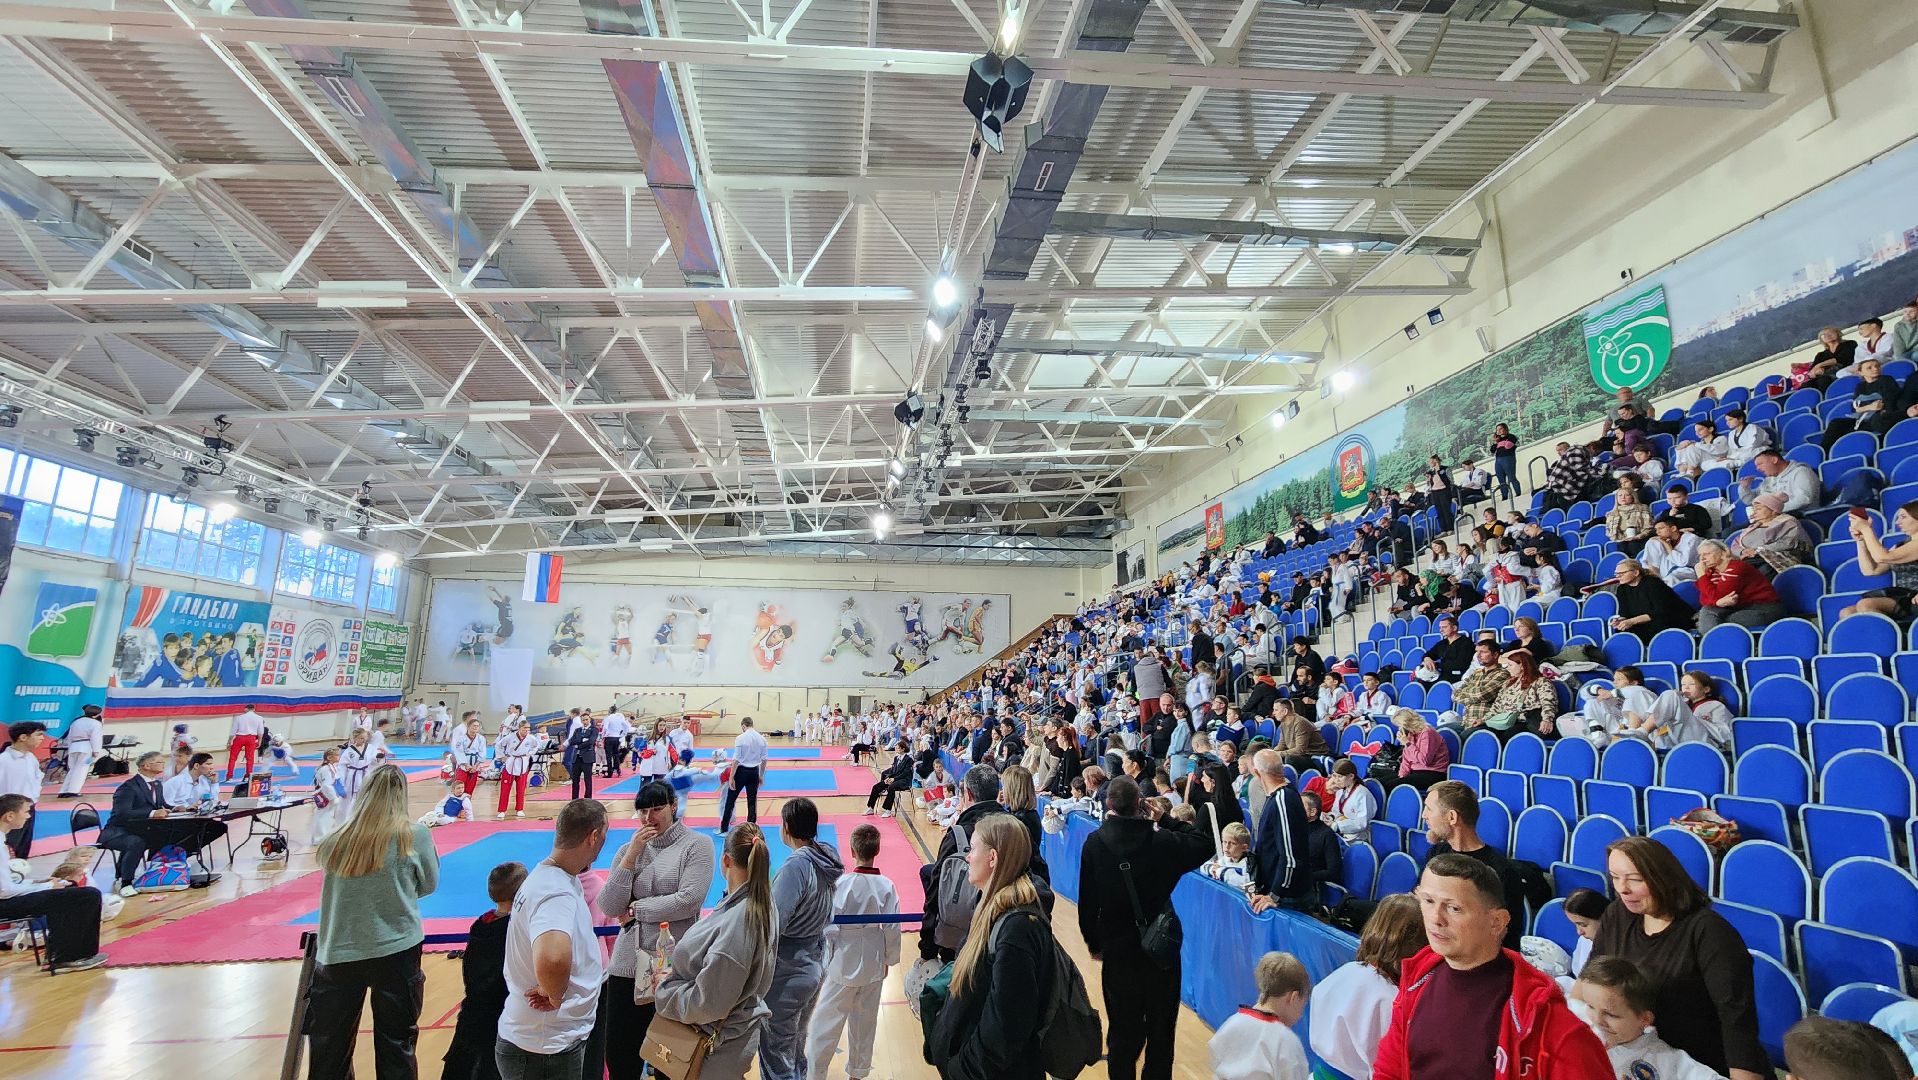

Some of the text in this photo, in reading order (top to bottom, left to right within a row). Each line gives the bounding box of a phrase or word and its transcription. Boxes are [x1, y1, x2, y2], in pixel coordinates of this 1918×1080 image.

[171, 596, 239, 620] ГАНДБОЛ
[298, 661, 329, 681] ЭРИДАН
[252, 782, 269, 793] 17 21
